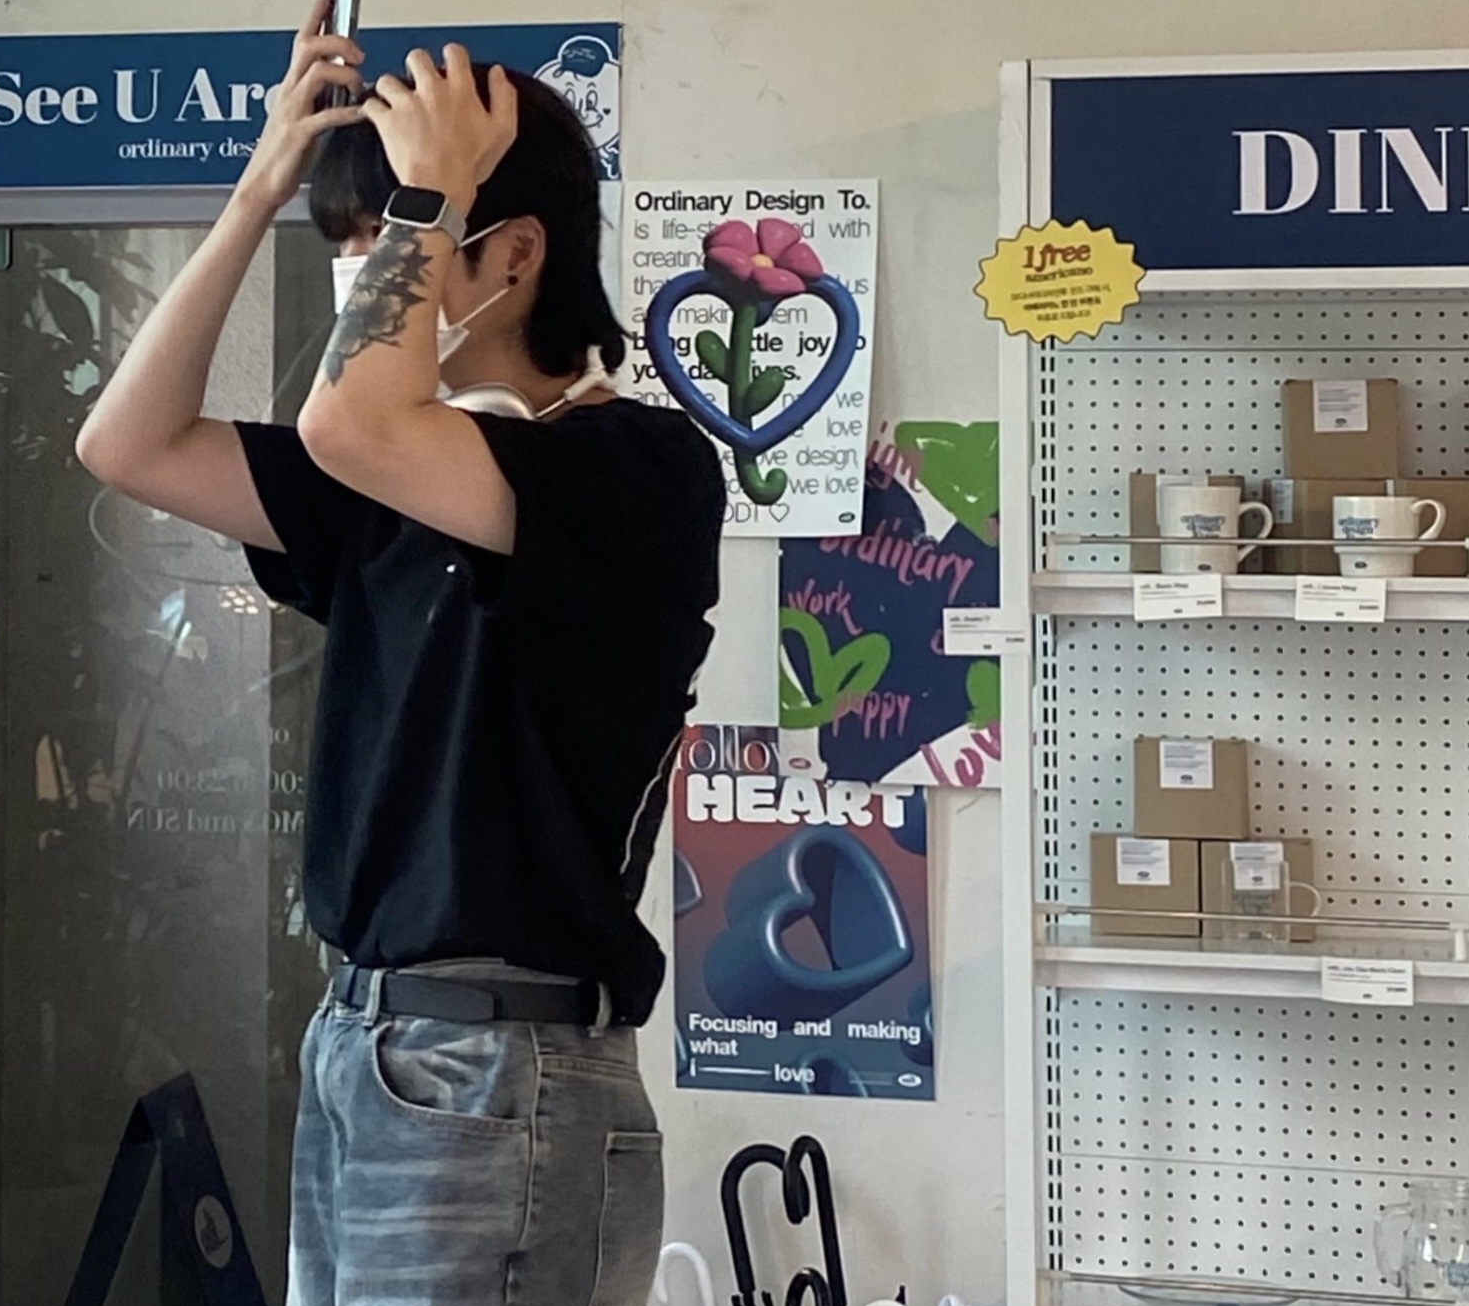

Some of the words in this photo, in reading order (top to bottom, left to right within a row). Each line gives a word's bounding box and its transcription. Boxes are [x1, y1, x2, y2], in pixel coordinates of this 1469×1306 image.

[113, 69, 162, 123] U
[118, 138, 213, 162] ordinary
[1232, 126, 1469, 214] DIN
[635, 190, 733, 215] Ordinary
[746, 189, 824, 215] Design
[837, 189, 871, 210] To.
[634, 219, 649, 240] is
[828, 218, 871, 239] with
[633, 250, 704, 268] creatin
[796, 331, 831, 357] joy
[835, 391, 864, 408] we
[827, 417, 862, 437] love
[789, 478, 820, 495] we
[825, 476, 859, 494] love
[920, 719, 1002, 787] lov
[686, 772, 915, 828] HEART
[689, 1013, 778, 1039] Focusing
[793, 1018, 831, 1037] and
[848, 1020, 921, 1045] making
[689, 1037, 739, 1056] what
[774, 1063, 816, 1083] love
